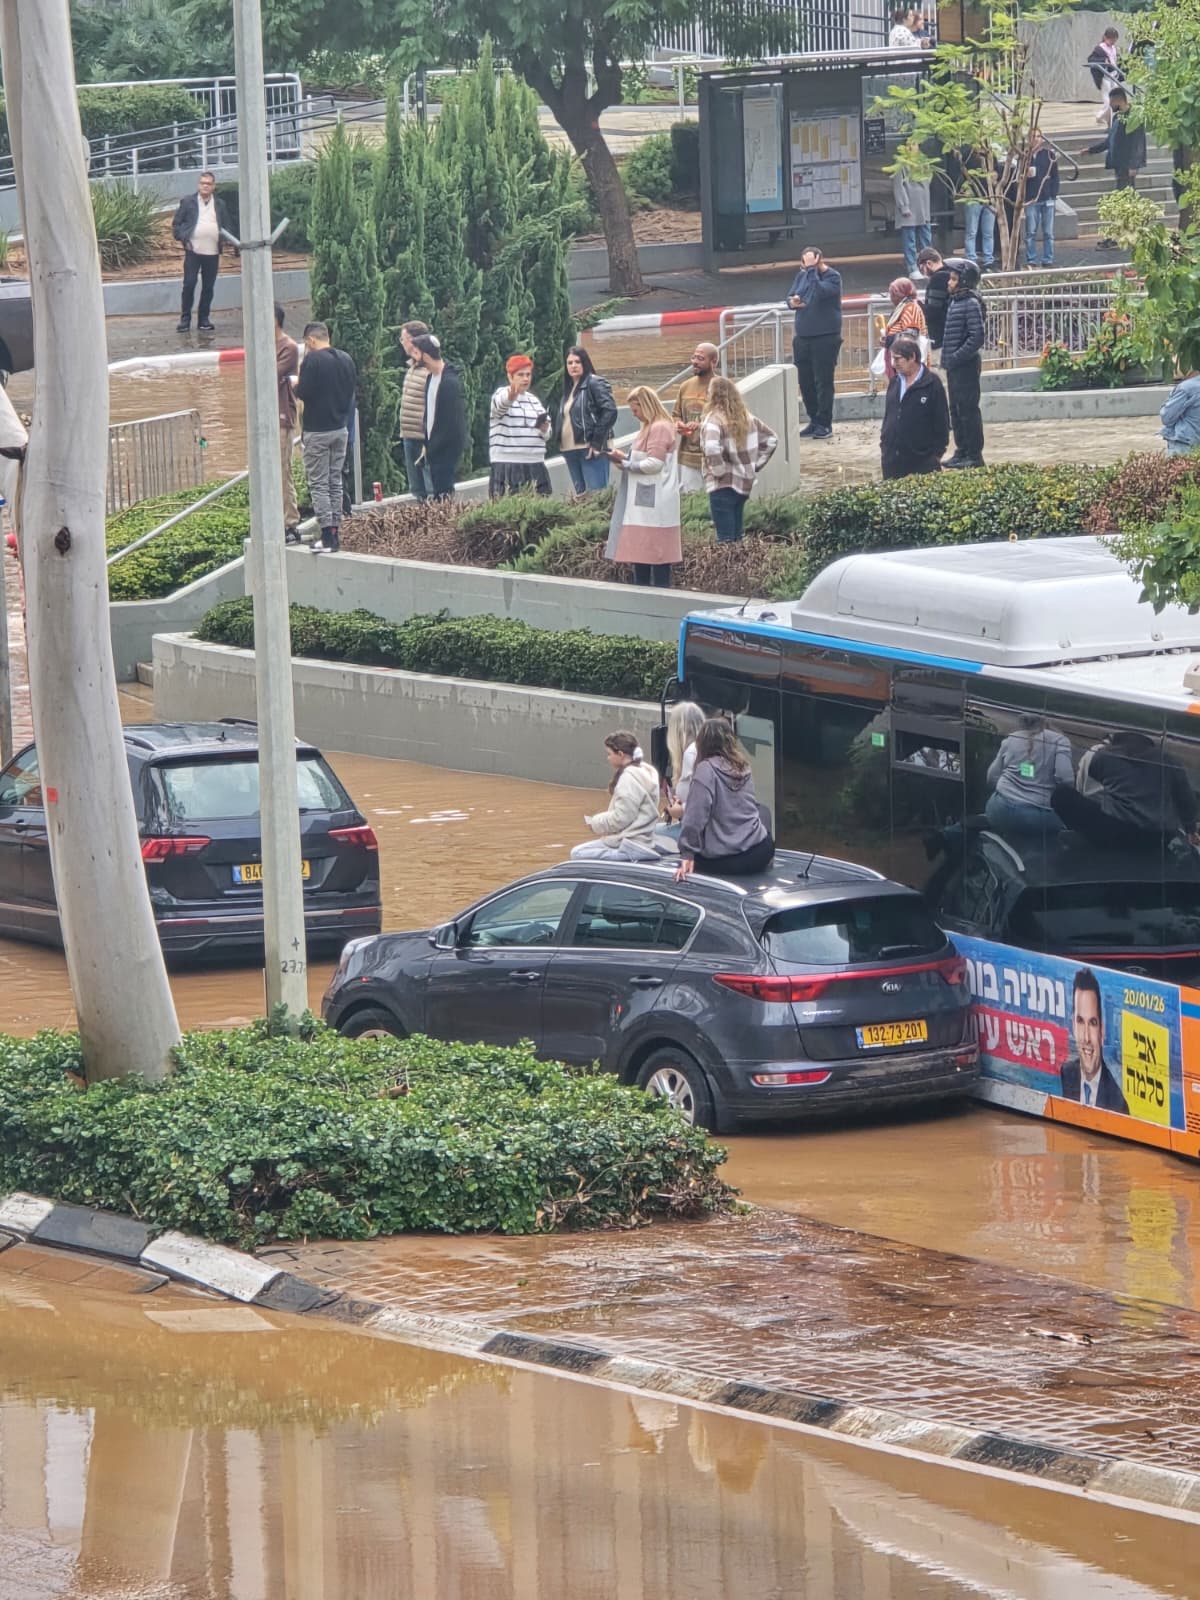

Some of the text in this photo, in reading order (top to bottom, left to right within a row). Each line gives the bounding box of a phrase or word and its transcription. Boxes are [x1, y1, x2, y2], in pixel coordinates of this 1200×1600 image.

[1004, 967, 1065, 1018] נתניה
[1124, 988, 1165, 1012] 20/01/26
[978, 1012, 1056, 1064] ראש עי
[1133, 1030, 1157, 1065] אבי
[1126, 1065, 1164, 1107] סלמה
